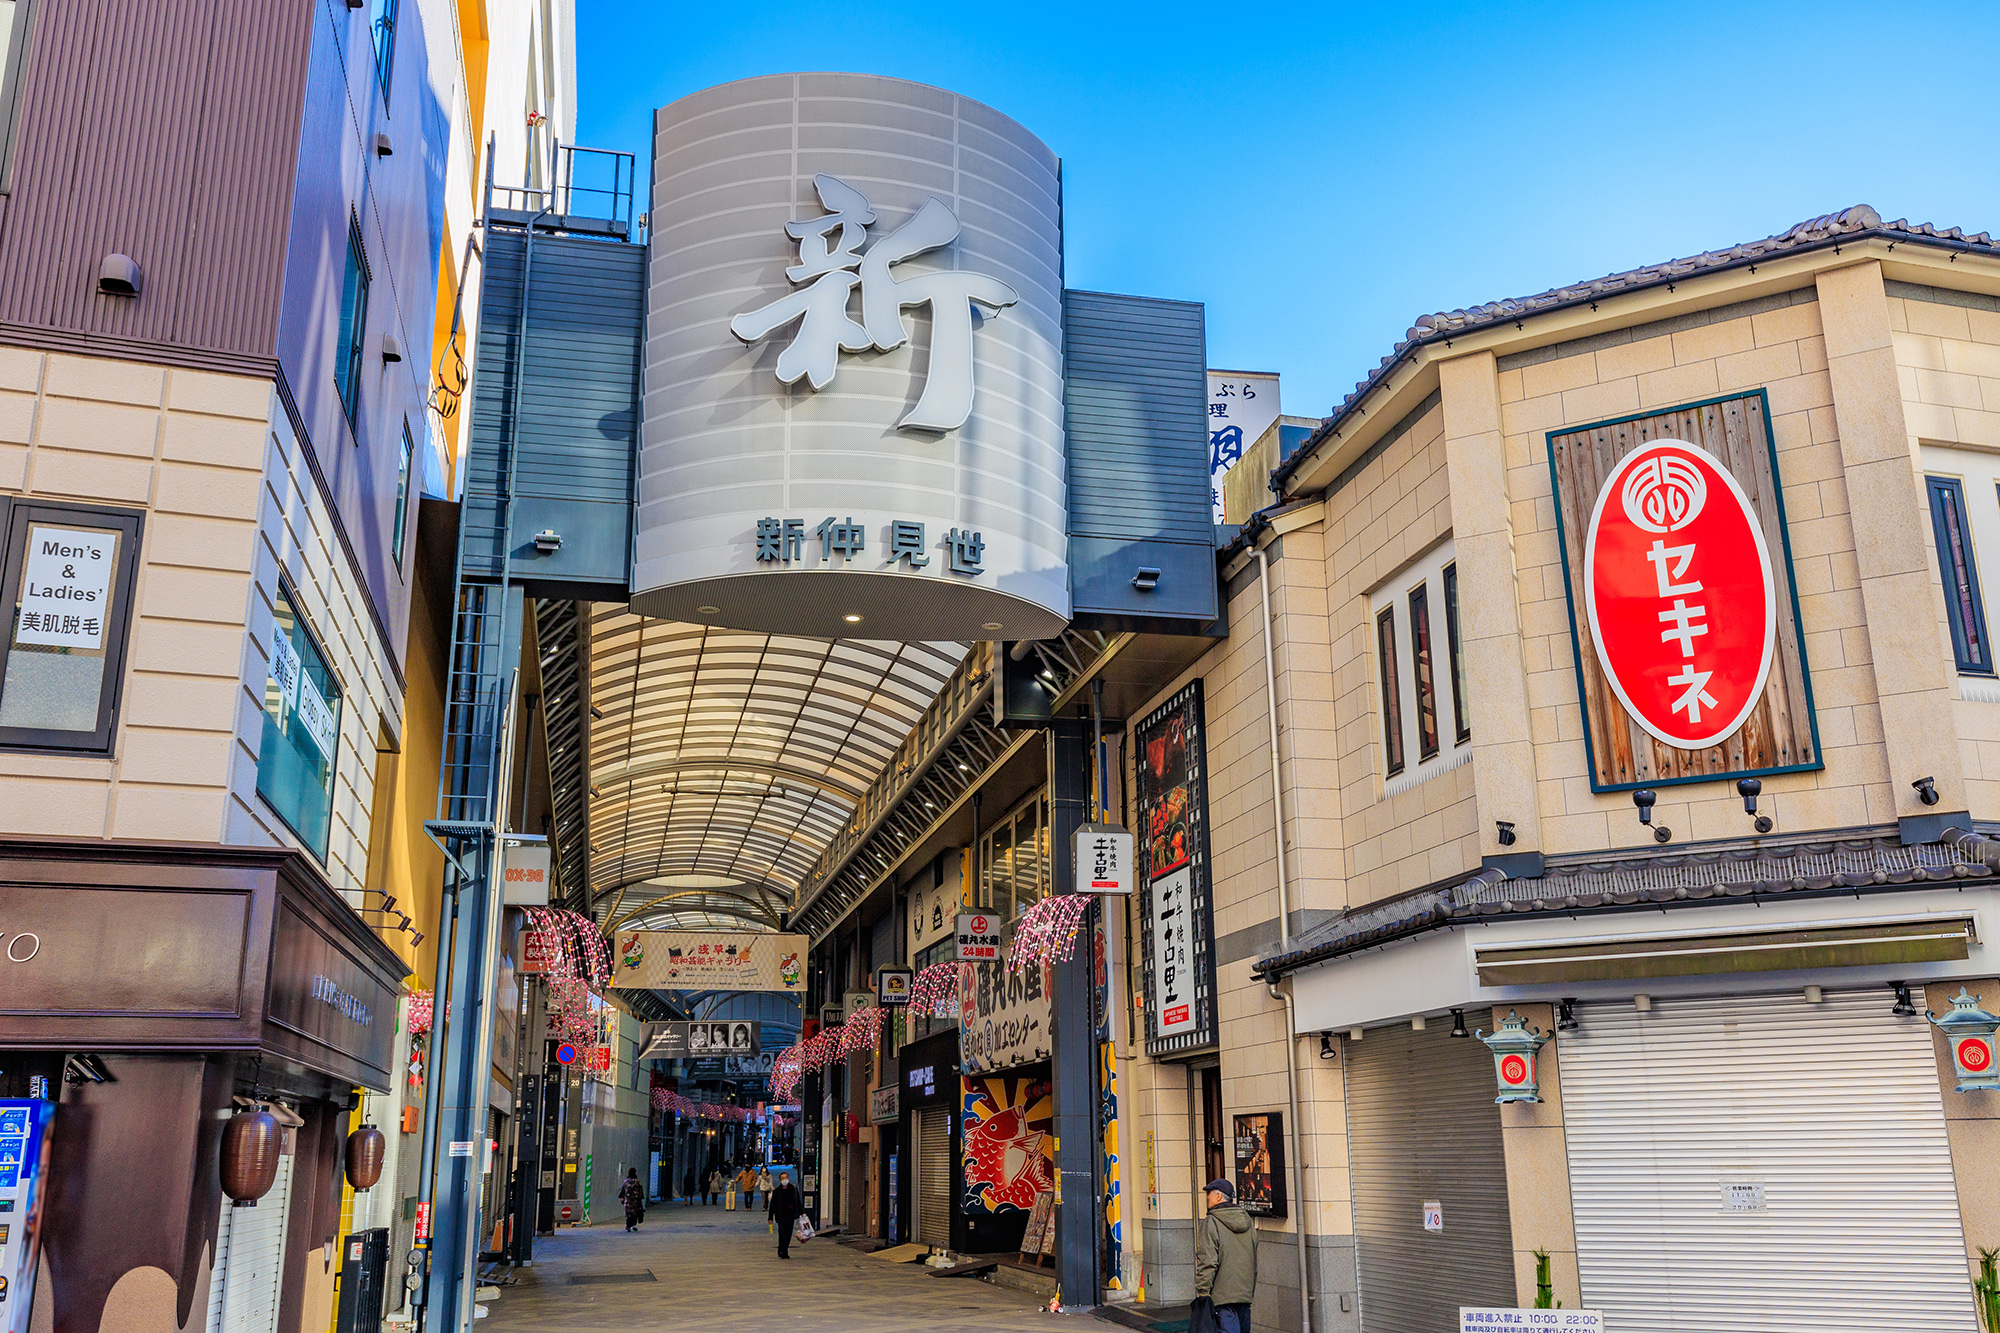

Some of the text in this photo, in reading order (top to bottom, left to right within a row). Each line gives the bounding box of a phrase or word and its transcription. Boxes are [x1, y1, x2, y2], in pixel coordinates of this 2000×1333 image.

[731, 173, 1019, 431] 新
[42, 541, 101, 560] Men's
[756, 517, 985, 575] 新仲見世
[62, 564, 75, 579] &
[29, 582, 103, 602] Ladies'
[22, 612, 99, 635] 美肌脱毛
[1647, 539, 1719, 723] セキネ
[302, 684, 332, 746] Glossy Skin
[1092, 837, 1109, 880] 土古里
[1109, 837, 1117, 868] 和牛焼肉
[1174, 881, 1185, 965] 和牛焼肉
[0, 932, 41, 962] O
[959, 934, 999, 945] 磯丸水産
[963, 947, 994, 957] 24時間
[1160, 886, 1179, 1005] 土古里
[1466, 1313, 1597, 1324] 車両進入禁止 10:00 22:00
